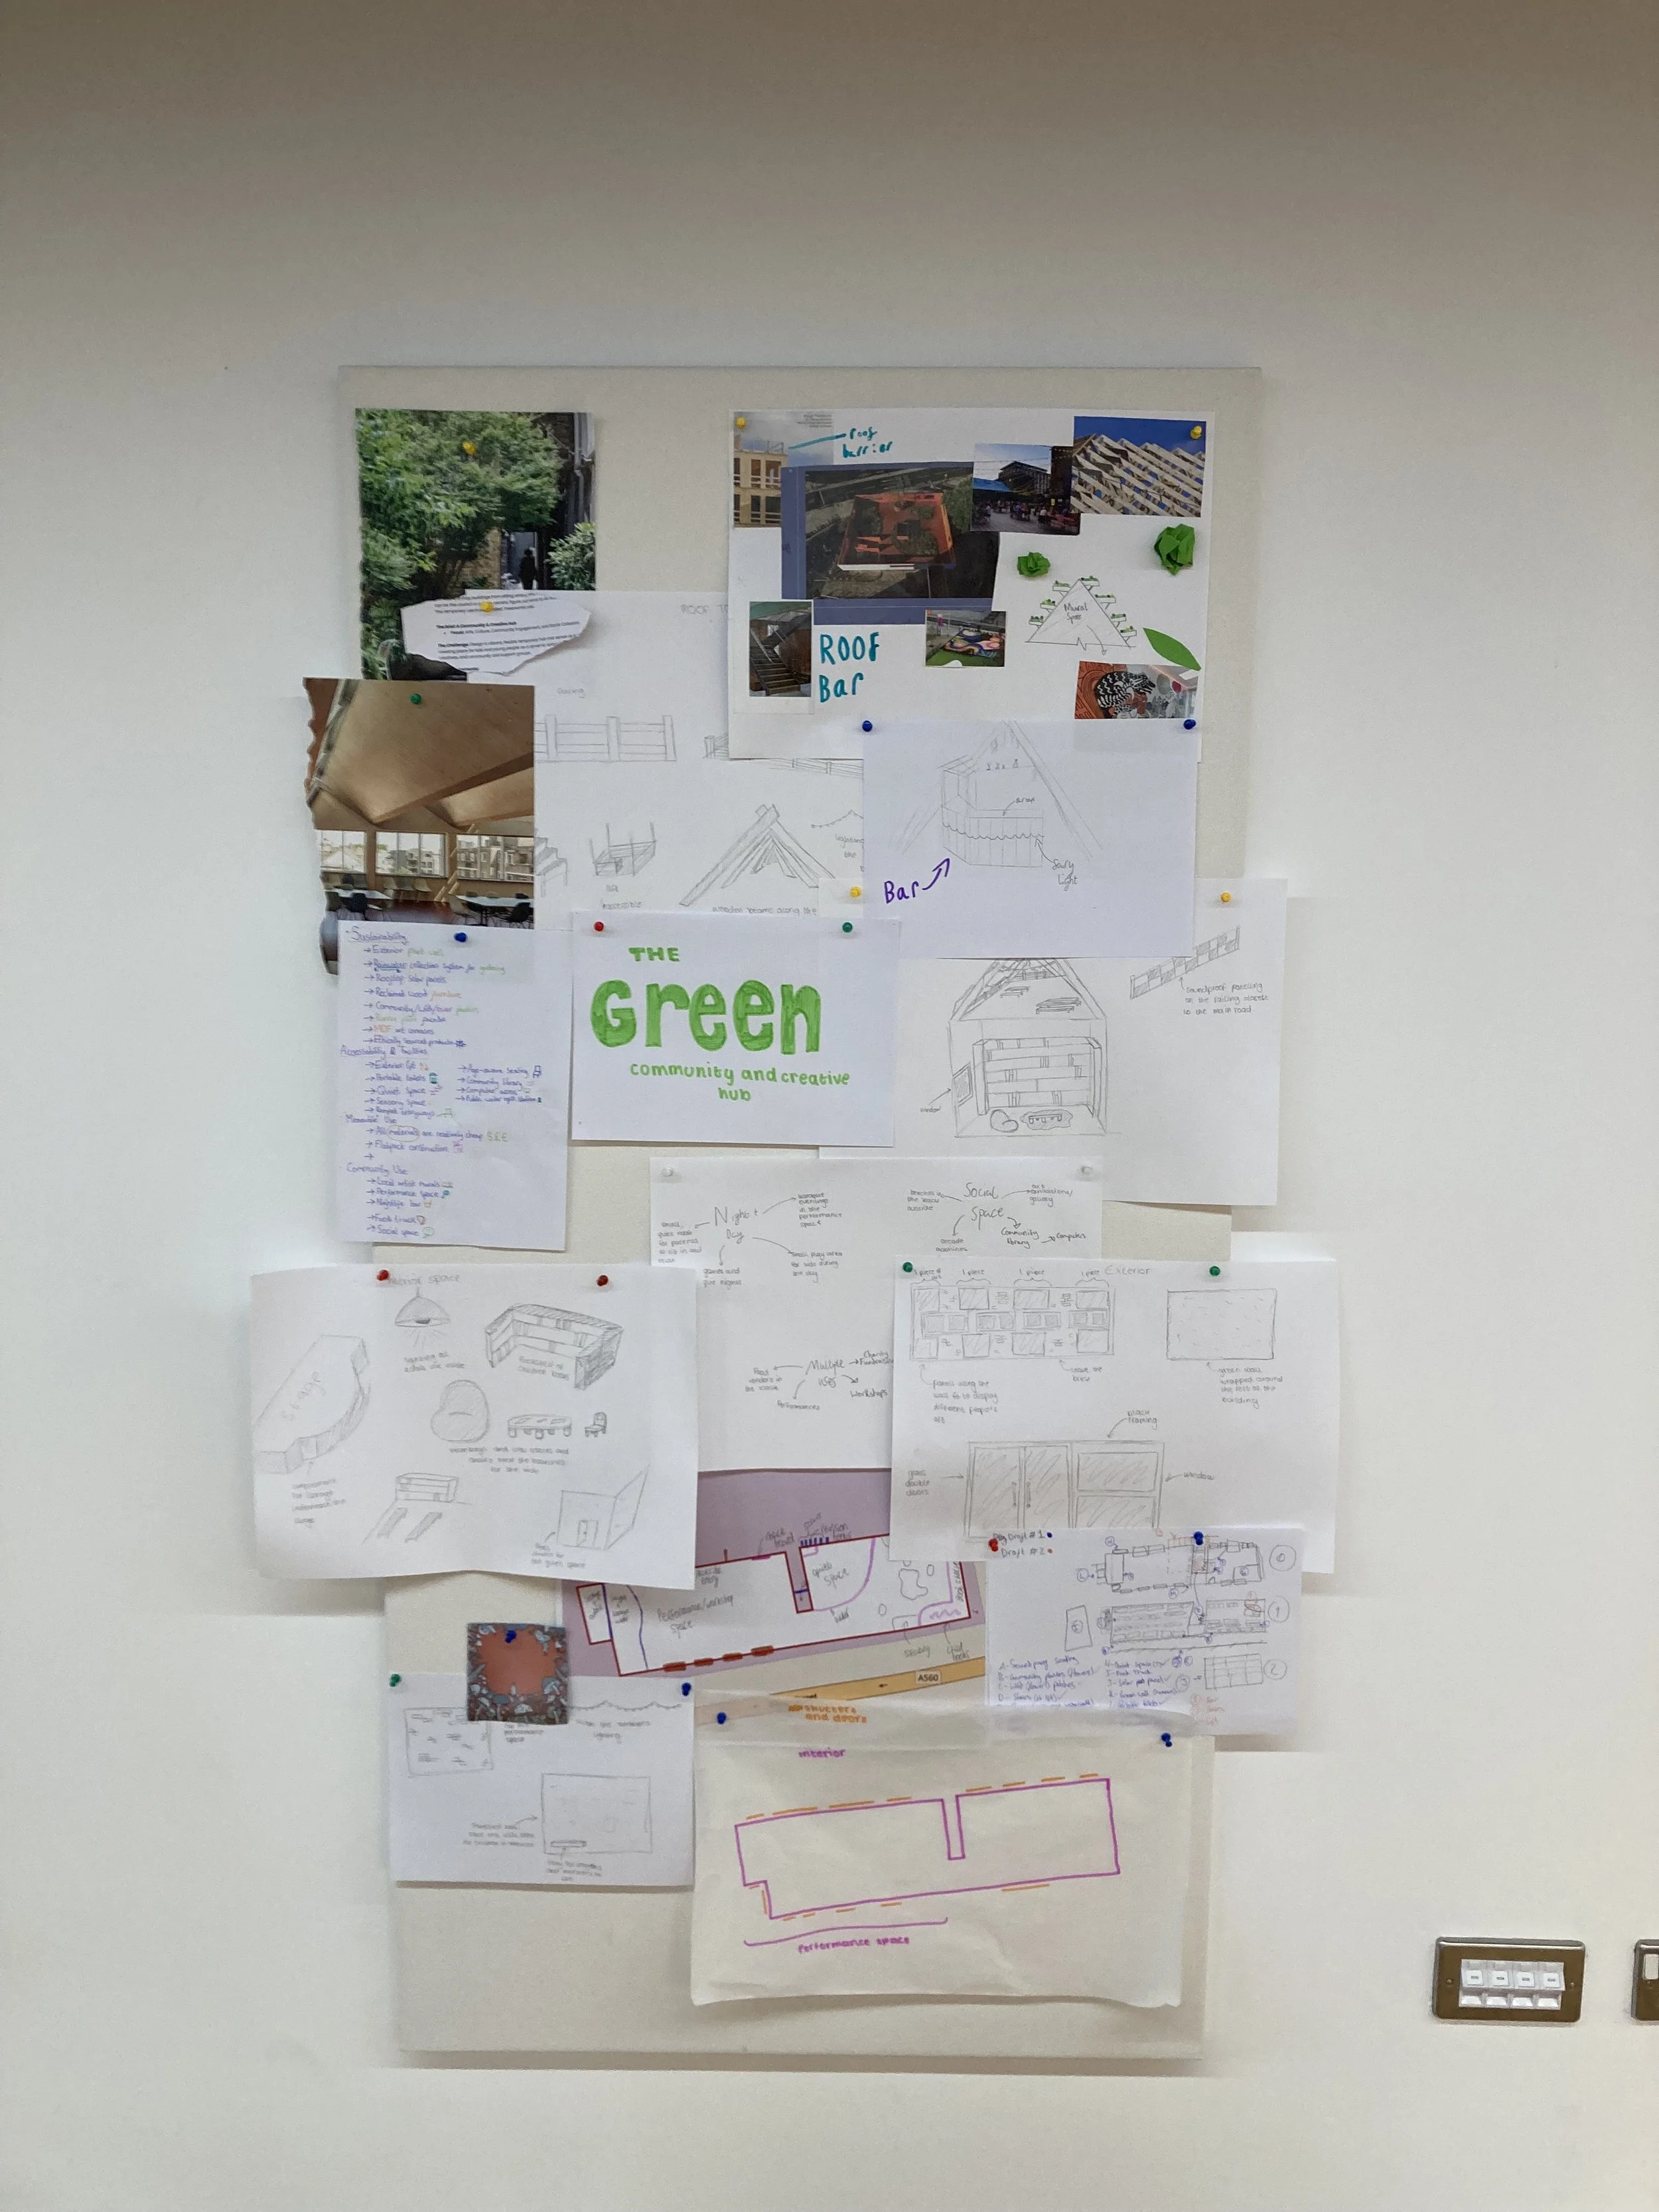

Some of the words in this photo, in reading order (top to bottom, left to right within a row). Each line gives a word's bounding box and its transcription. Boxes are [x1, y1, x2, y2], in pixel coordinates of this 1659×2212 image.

[1064, 603, 1088, 613] Mural
[820, 632, 880, 664] ROOF
[819, 673, 864, 703] Bar
[884, 881, 920, 904] Bar
[628, 947, 680, 961] THE
[590, 980, 821, 1055] Green
[630, 1063, 734, 1086] community
[742, 1069, 777, 1082] and
[781, 1070, 850, 1086] creative
[718, 1087, 751, 1102] hub
[877, 1937, 910, 1947] space
